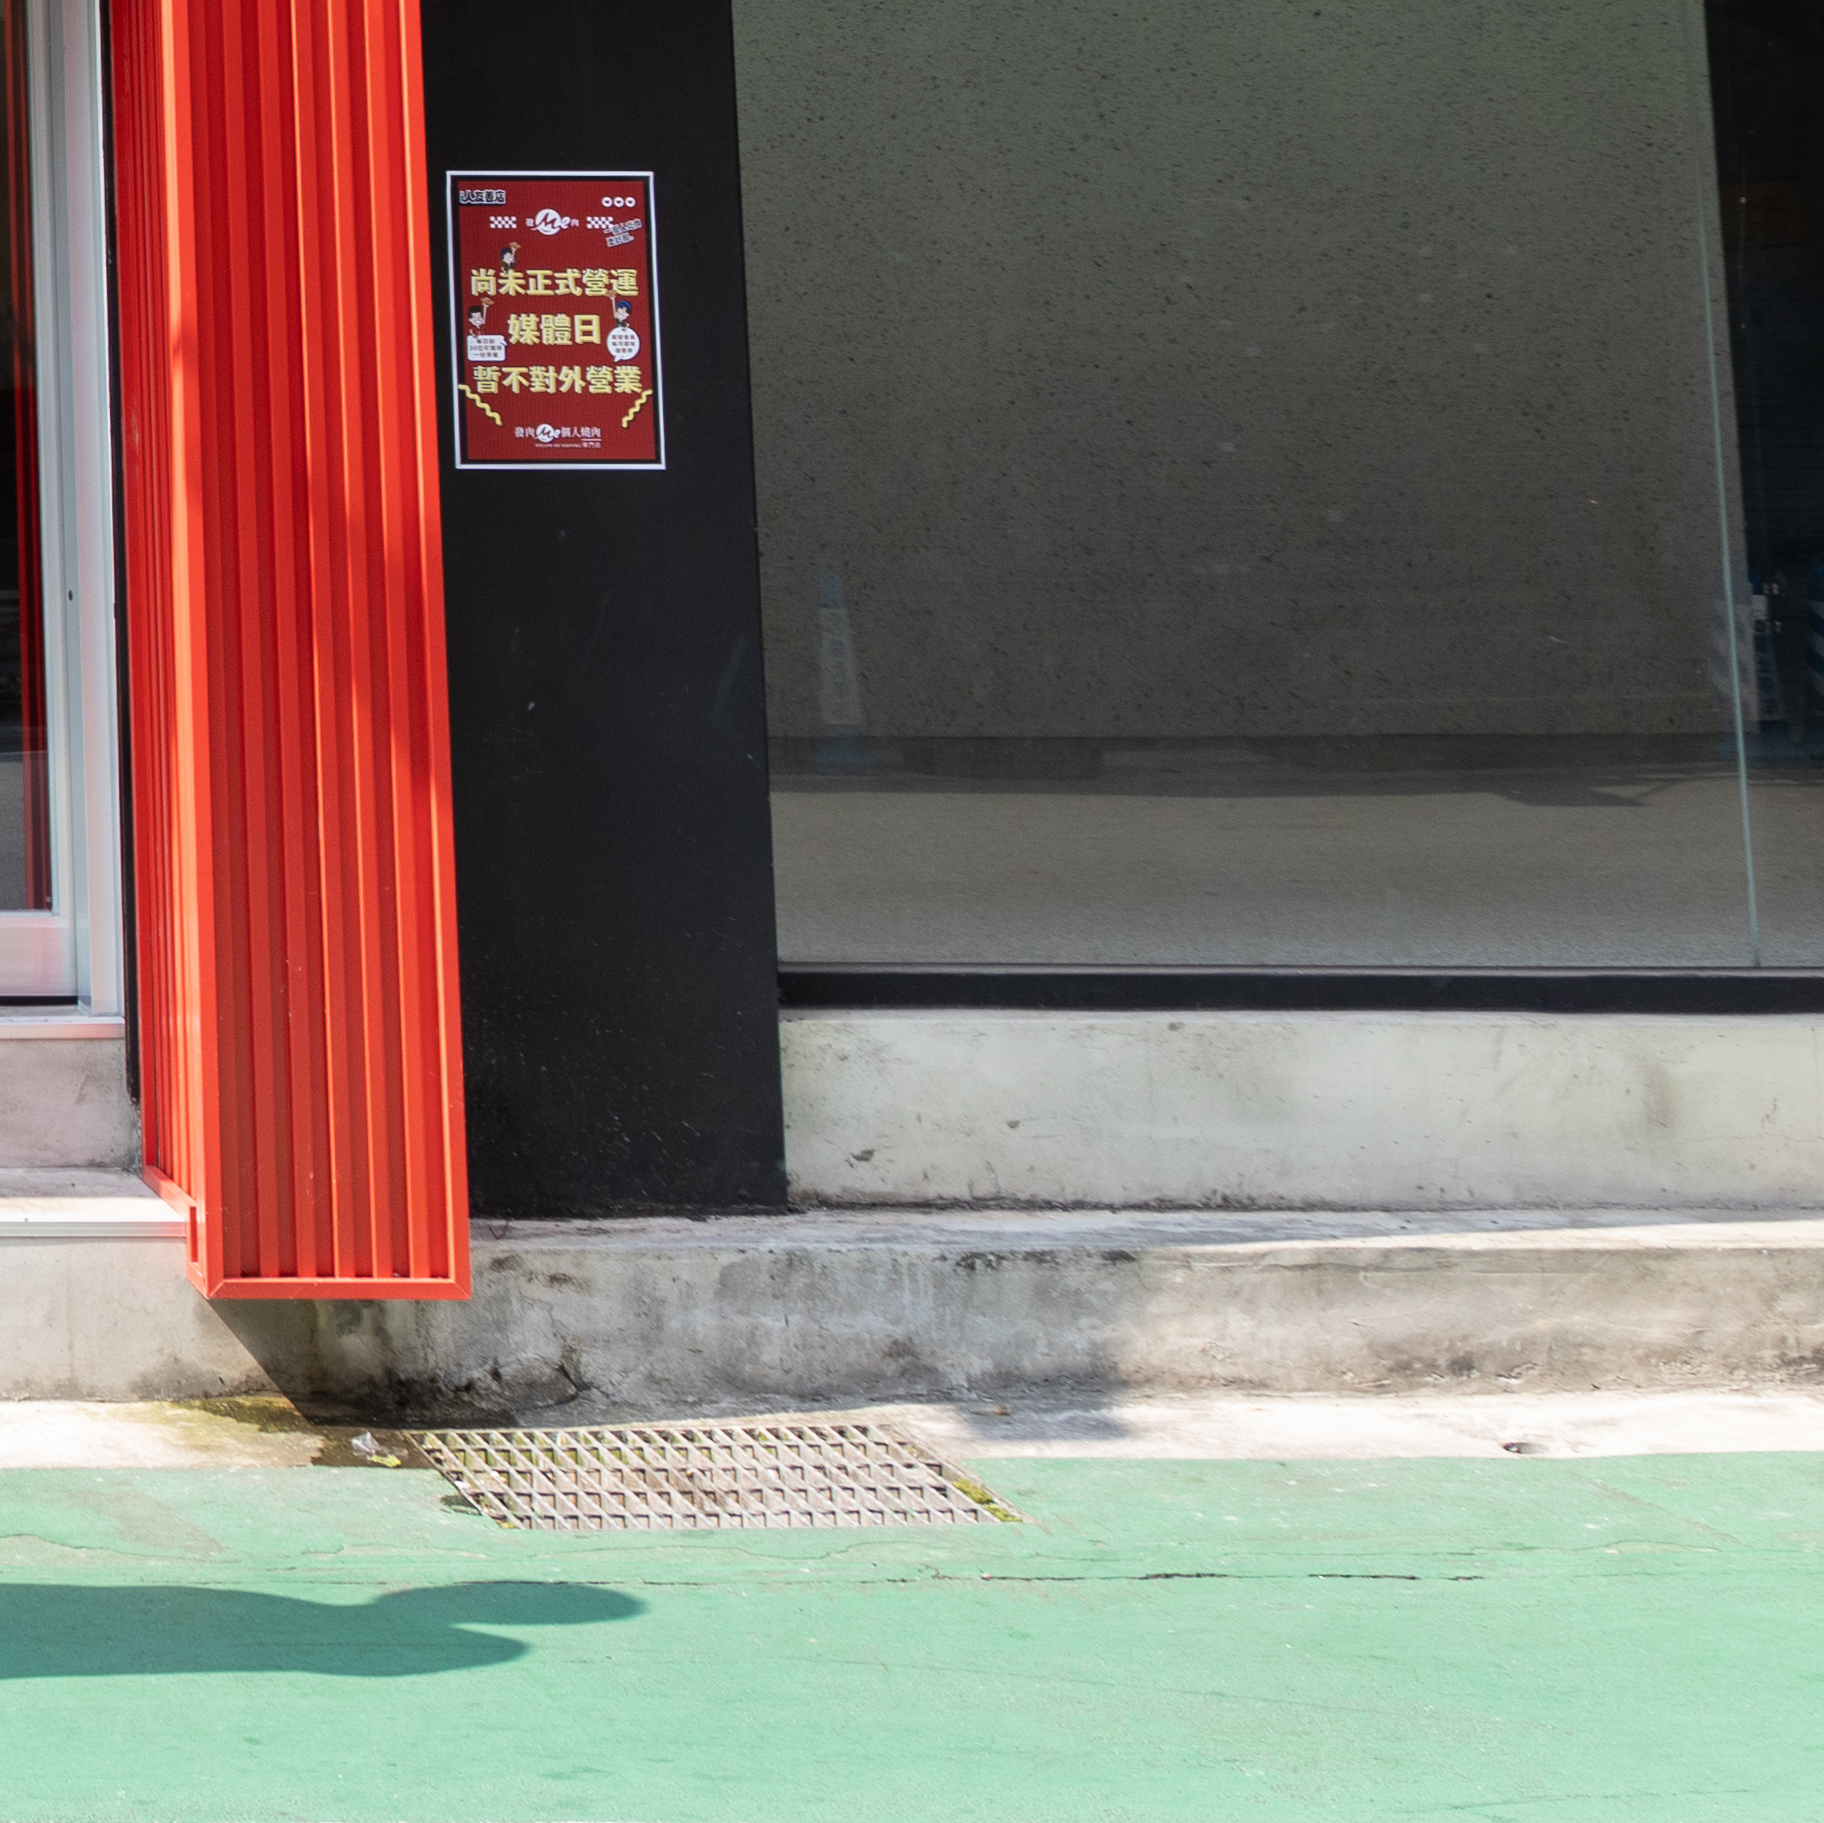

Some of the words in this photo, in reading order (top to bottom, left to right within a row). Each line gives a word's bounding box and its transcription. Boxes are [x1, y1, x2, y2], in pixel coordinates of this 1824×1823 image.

[470, 267, 639, 297] 尚未正式營運
[507, 313, 602, 346] 媒體日
[473, 365, 643, 394] 暫不對外營業
